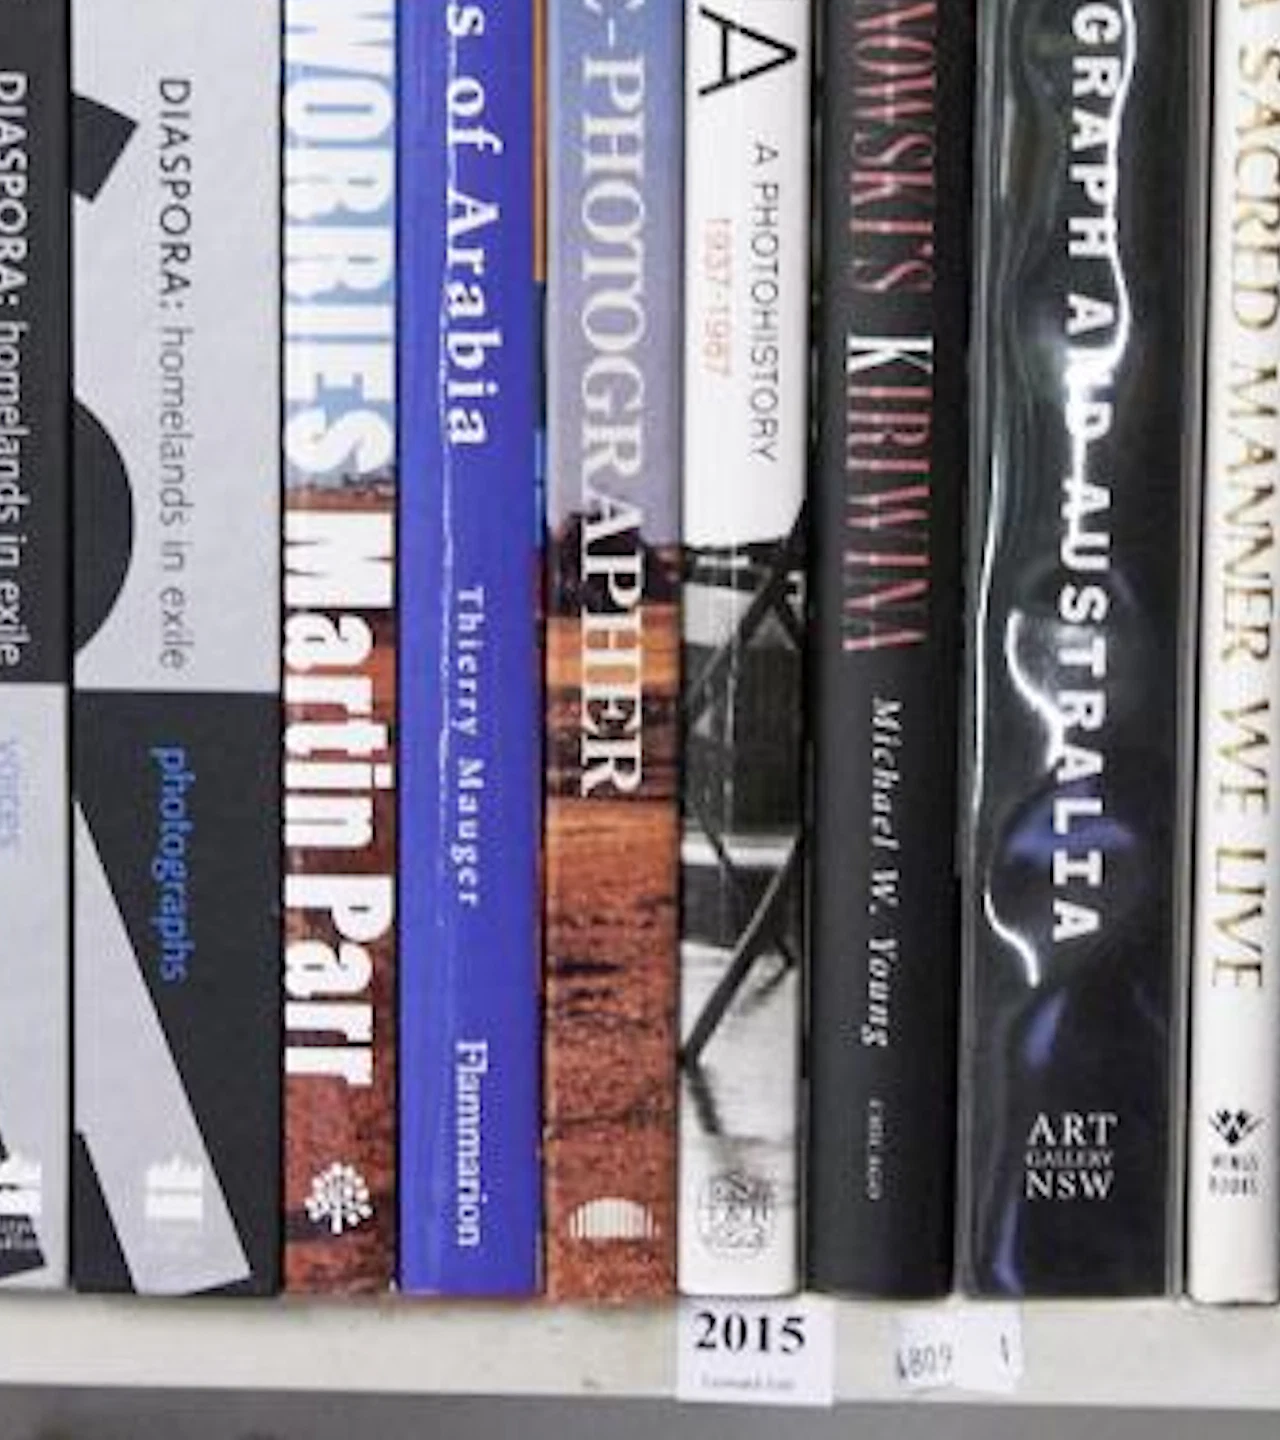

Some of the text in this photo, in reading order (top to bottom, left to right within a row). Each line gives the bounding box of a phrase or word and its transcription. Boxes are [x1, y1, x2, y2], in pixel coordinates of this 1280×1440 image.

[449, 77, 504, 154] of
[159, 79, 194, 670] DIASPORA: homelands in exile
[445, 188, 503, 448] Arabia
[750, 142, 780, 464] A PHOTOHISTORY
[844, 335, 934, 652] KIRIWINA
[1221, 365, 1278, 661] MANNER
[285, 510, 393, 849] Martin
[447, 587, 485, 906] Thierry Mauger
[1051, 480, 1112, 942] AUSTRALIA
[1219, 697, 1271, 816] WE
[151, 746, 196, 983] photographs
[285, 874, 393, 1087] Parr
[862, 697, 901, 1048] Michael W. Young
[1212, 848, 1268, 989] LIVE
[455, 1041, 489, 1246] Flammarion
[1025, 1170, 1113, 1200] NSW
[1026, 1113, 1118, 1148] ART
[694, 1311, 807, 1353] 2015
